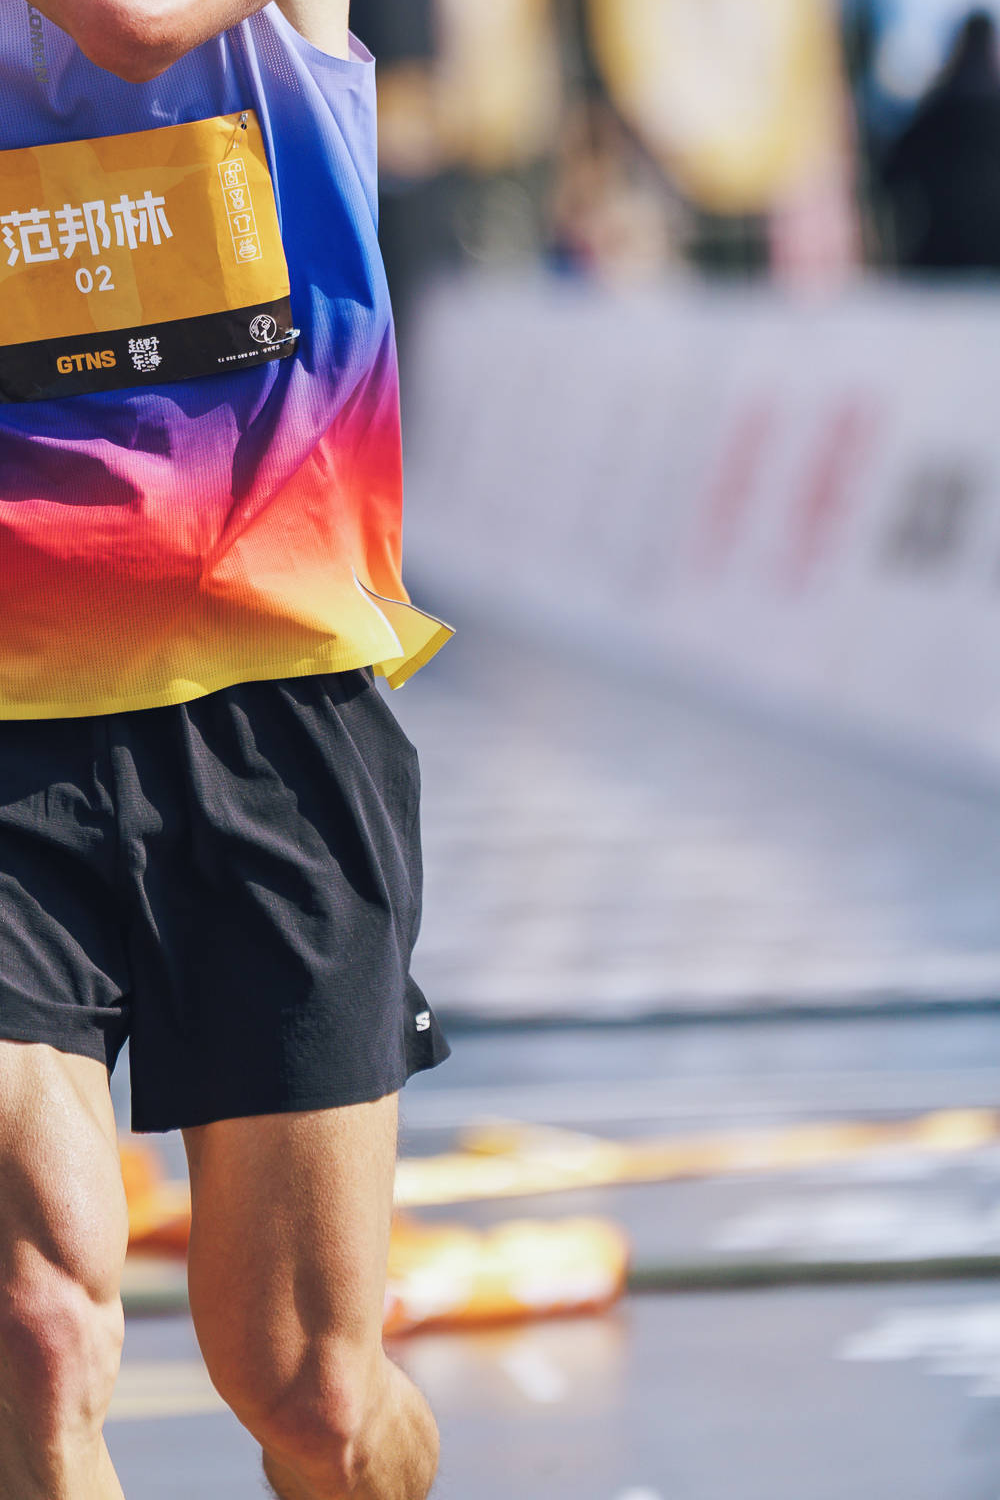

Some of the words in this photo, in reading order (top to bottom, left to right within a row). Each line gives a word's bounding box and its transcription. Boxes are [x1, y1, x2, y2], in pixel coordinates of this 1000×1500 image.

[0, 190, 173, 267] 范邦林
[75, 265, 115, 294] 02
[56, 350, 117, 374] GTNS
